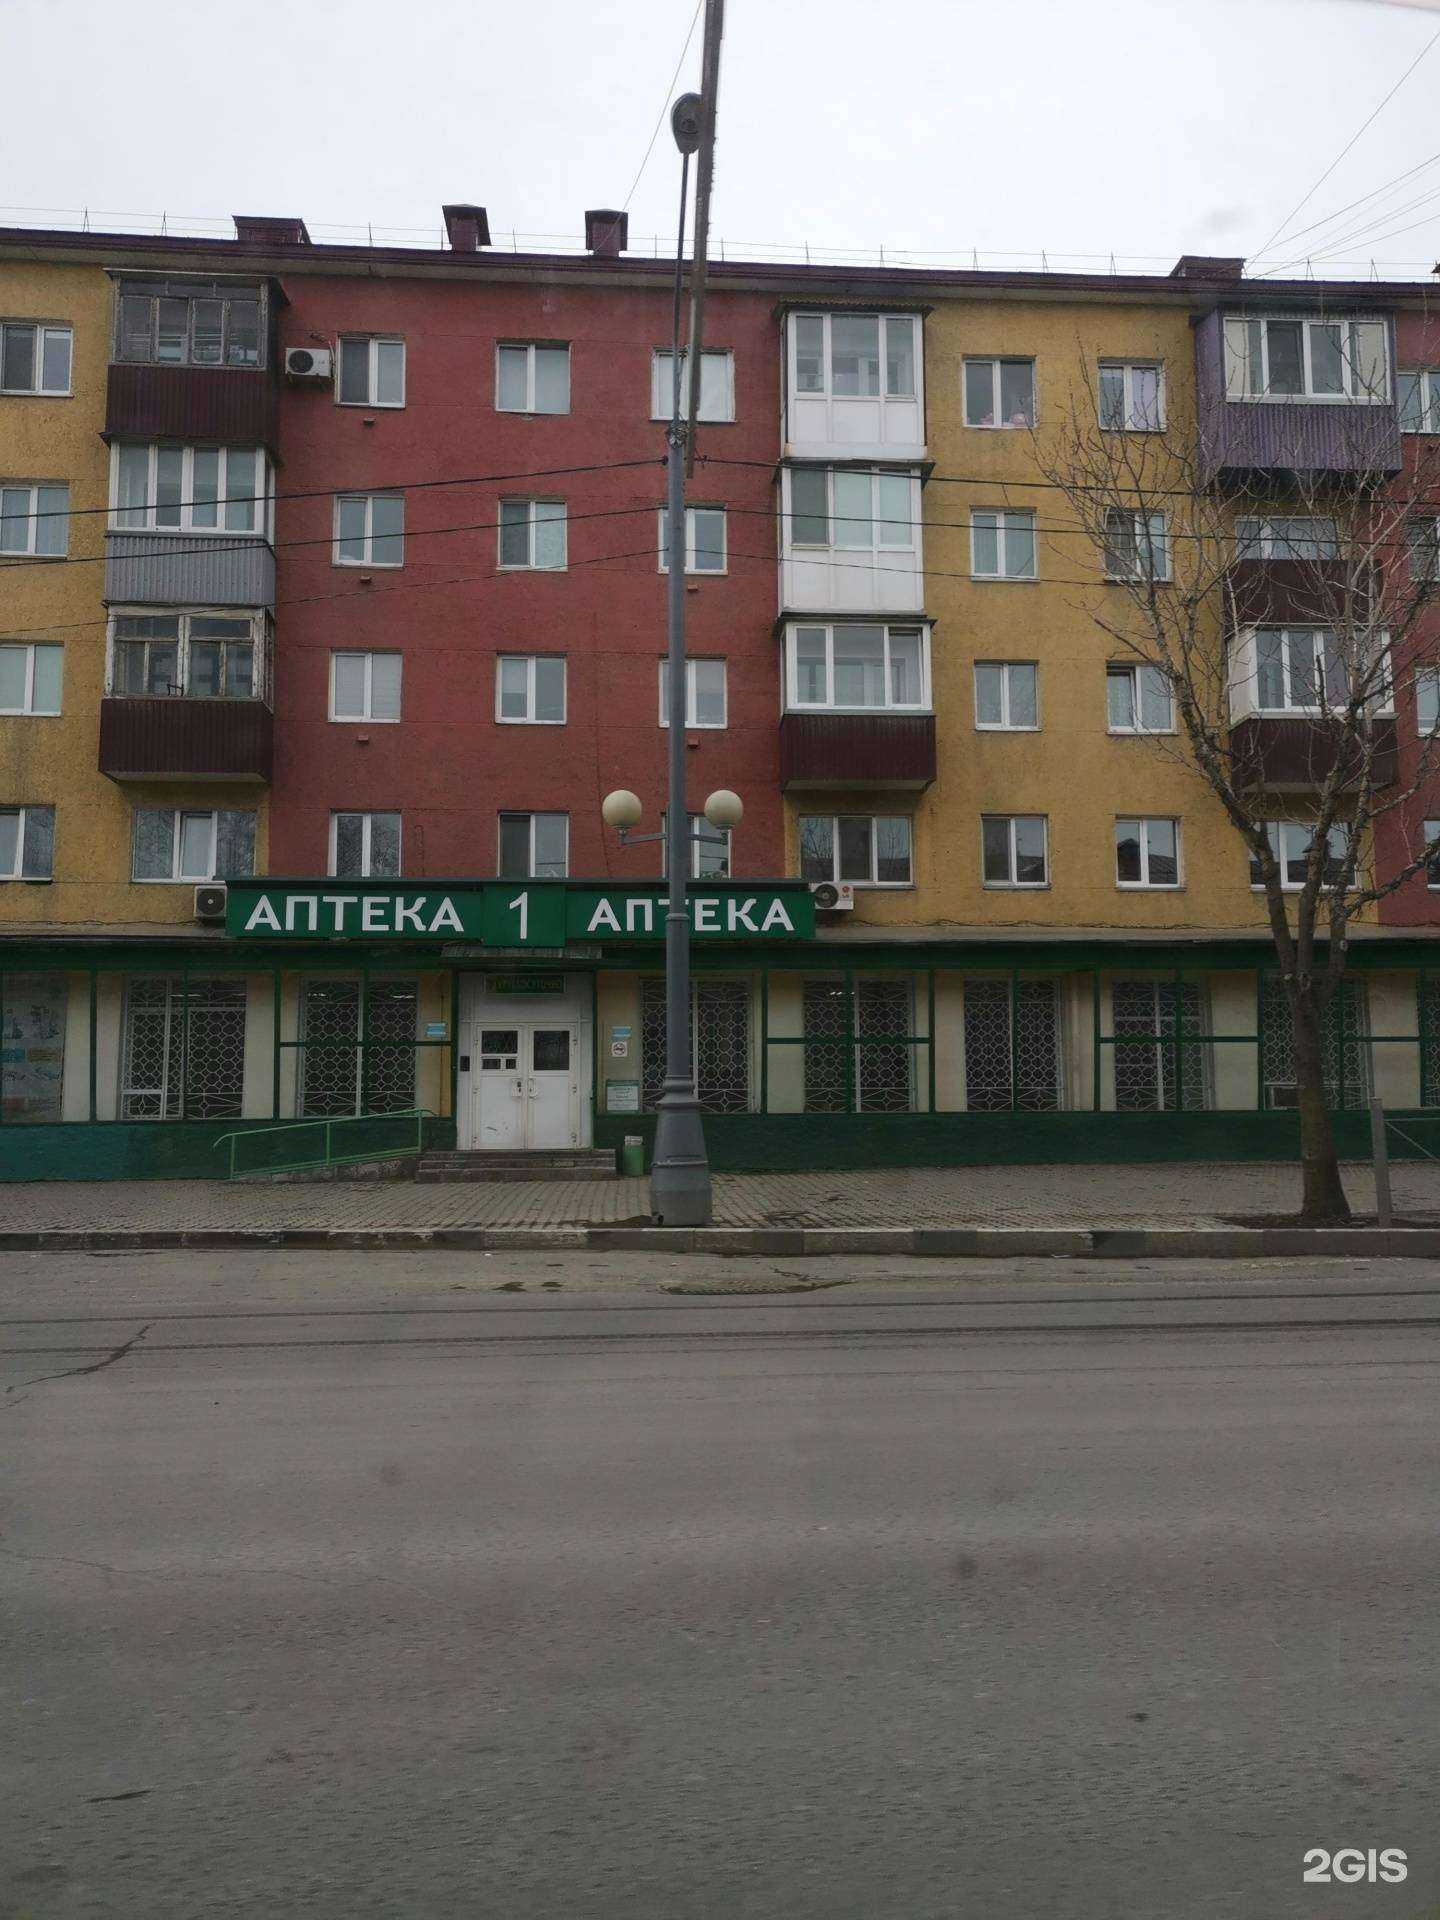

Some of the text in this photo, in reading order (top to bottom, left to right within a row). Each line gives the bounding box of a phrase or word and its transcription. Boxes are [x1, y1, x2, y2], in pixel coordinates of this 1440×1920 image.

[244, 891, 795, 940] АПТЕКА 1 АПЕКА
